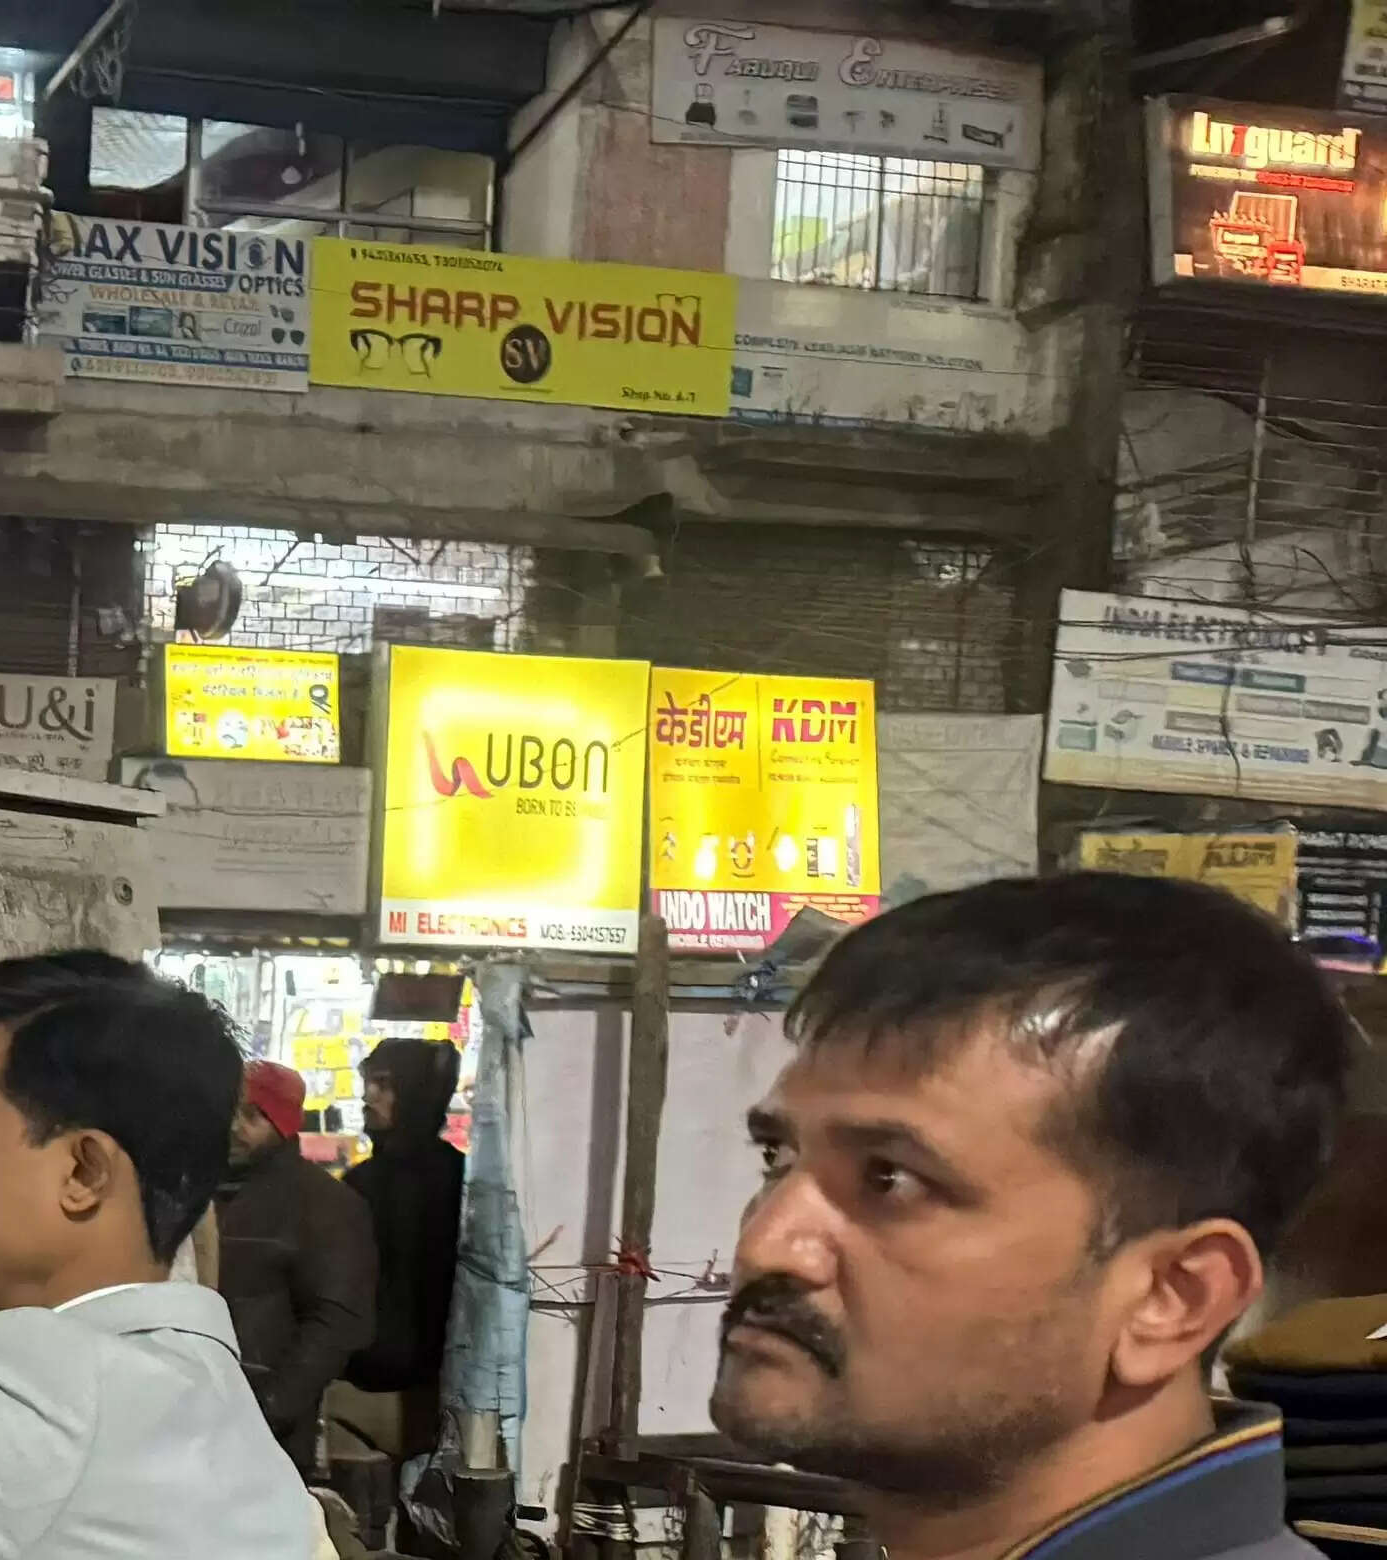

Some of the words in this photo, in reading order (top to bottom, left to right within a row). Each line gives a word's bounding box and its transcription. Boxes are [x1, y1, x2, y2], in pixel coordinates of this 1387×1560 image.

[73, 223, 142, 262] AX
[238, 274, 305, 297] OPTICS
[349, 280, 522, 332] SHARP
[544, 297, 701, 347] VISION
[505, 337, 549, 371] SV
[656, 691, 748, 750] केडीएम
[772, 698, 858, 744] KDM
[515, 796, 547, 815] BORN
[389, 911, 408, 933] MI
[660, 891, 706, 930] INDO
[707, 891, 771, 932] WATCH
